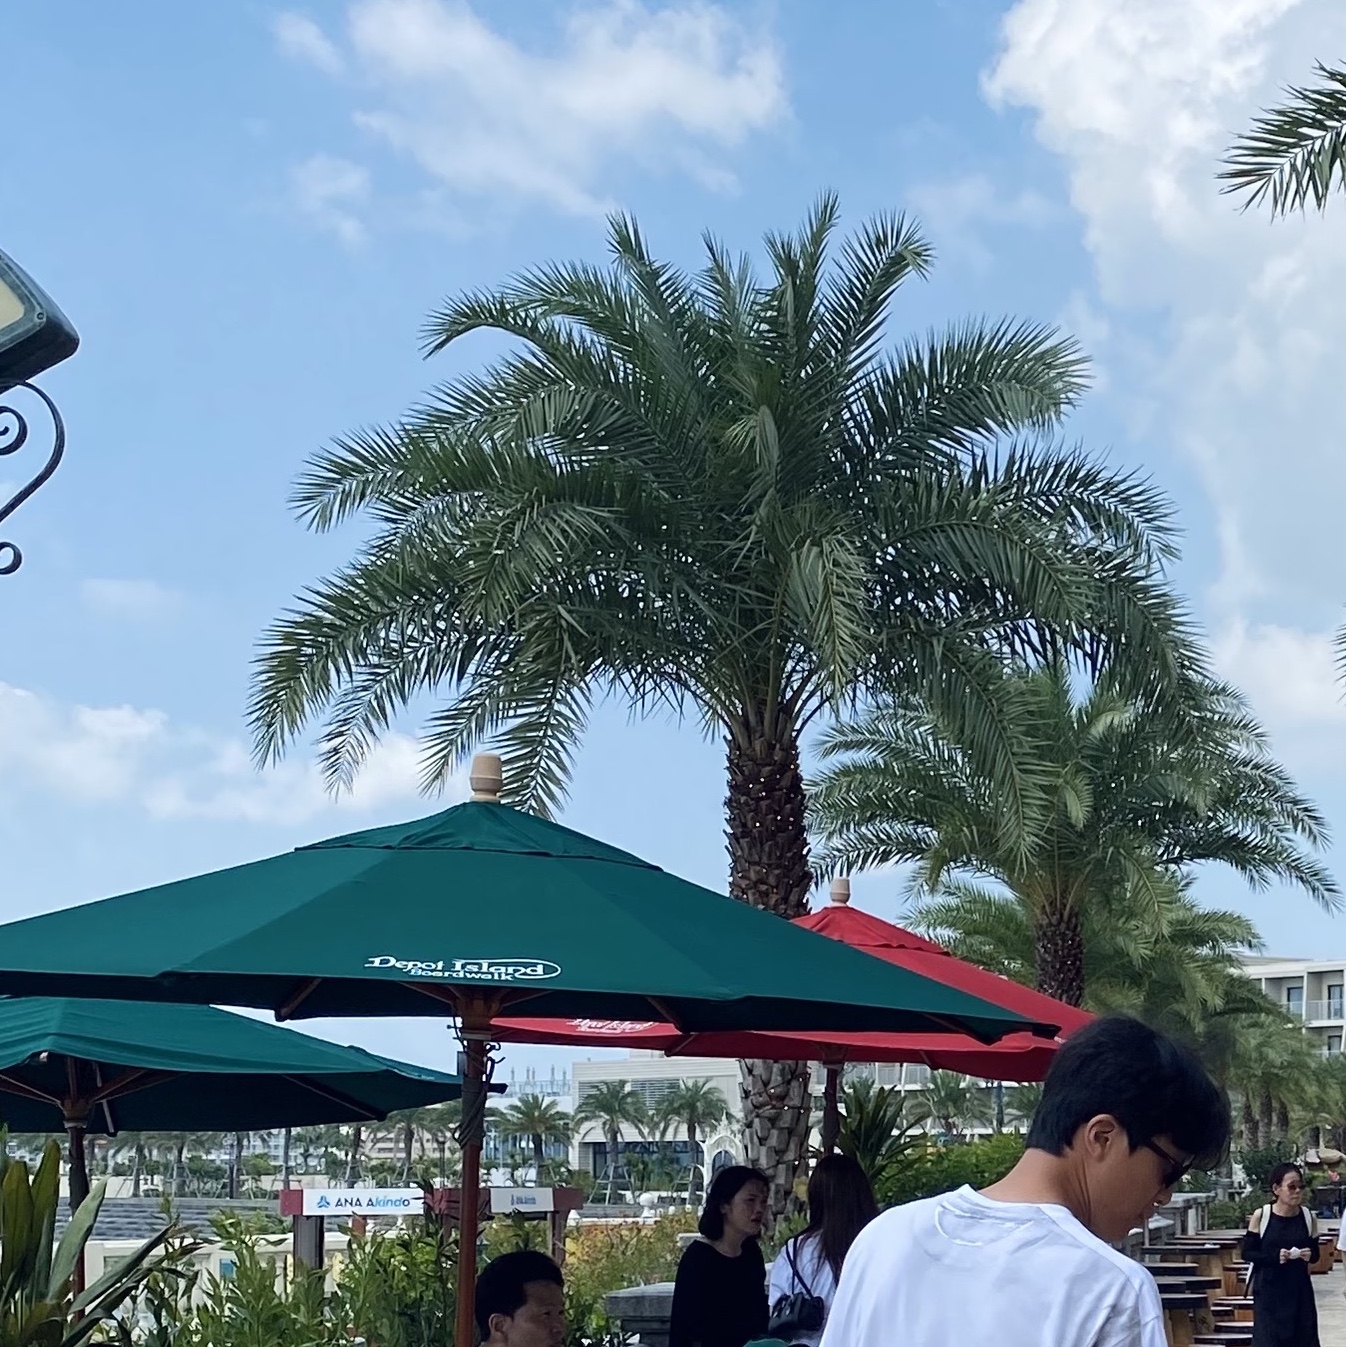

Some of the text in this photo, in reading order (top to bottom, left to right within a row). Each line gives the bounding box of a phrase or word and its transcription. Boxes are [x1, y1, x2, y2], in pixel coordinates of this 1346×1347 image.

[364, 955, 546, 977] Depot Island
[409, 968, 515, 981] Boardwalk
[334, 1196, 411, 1208] ANA Akindo
